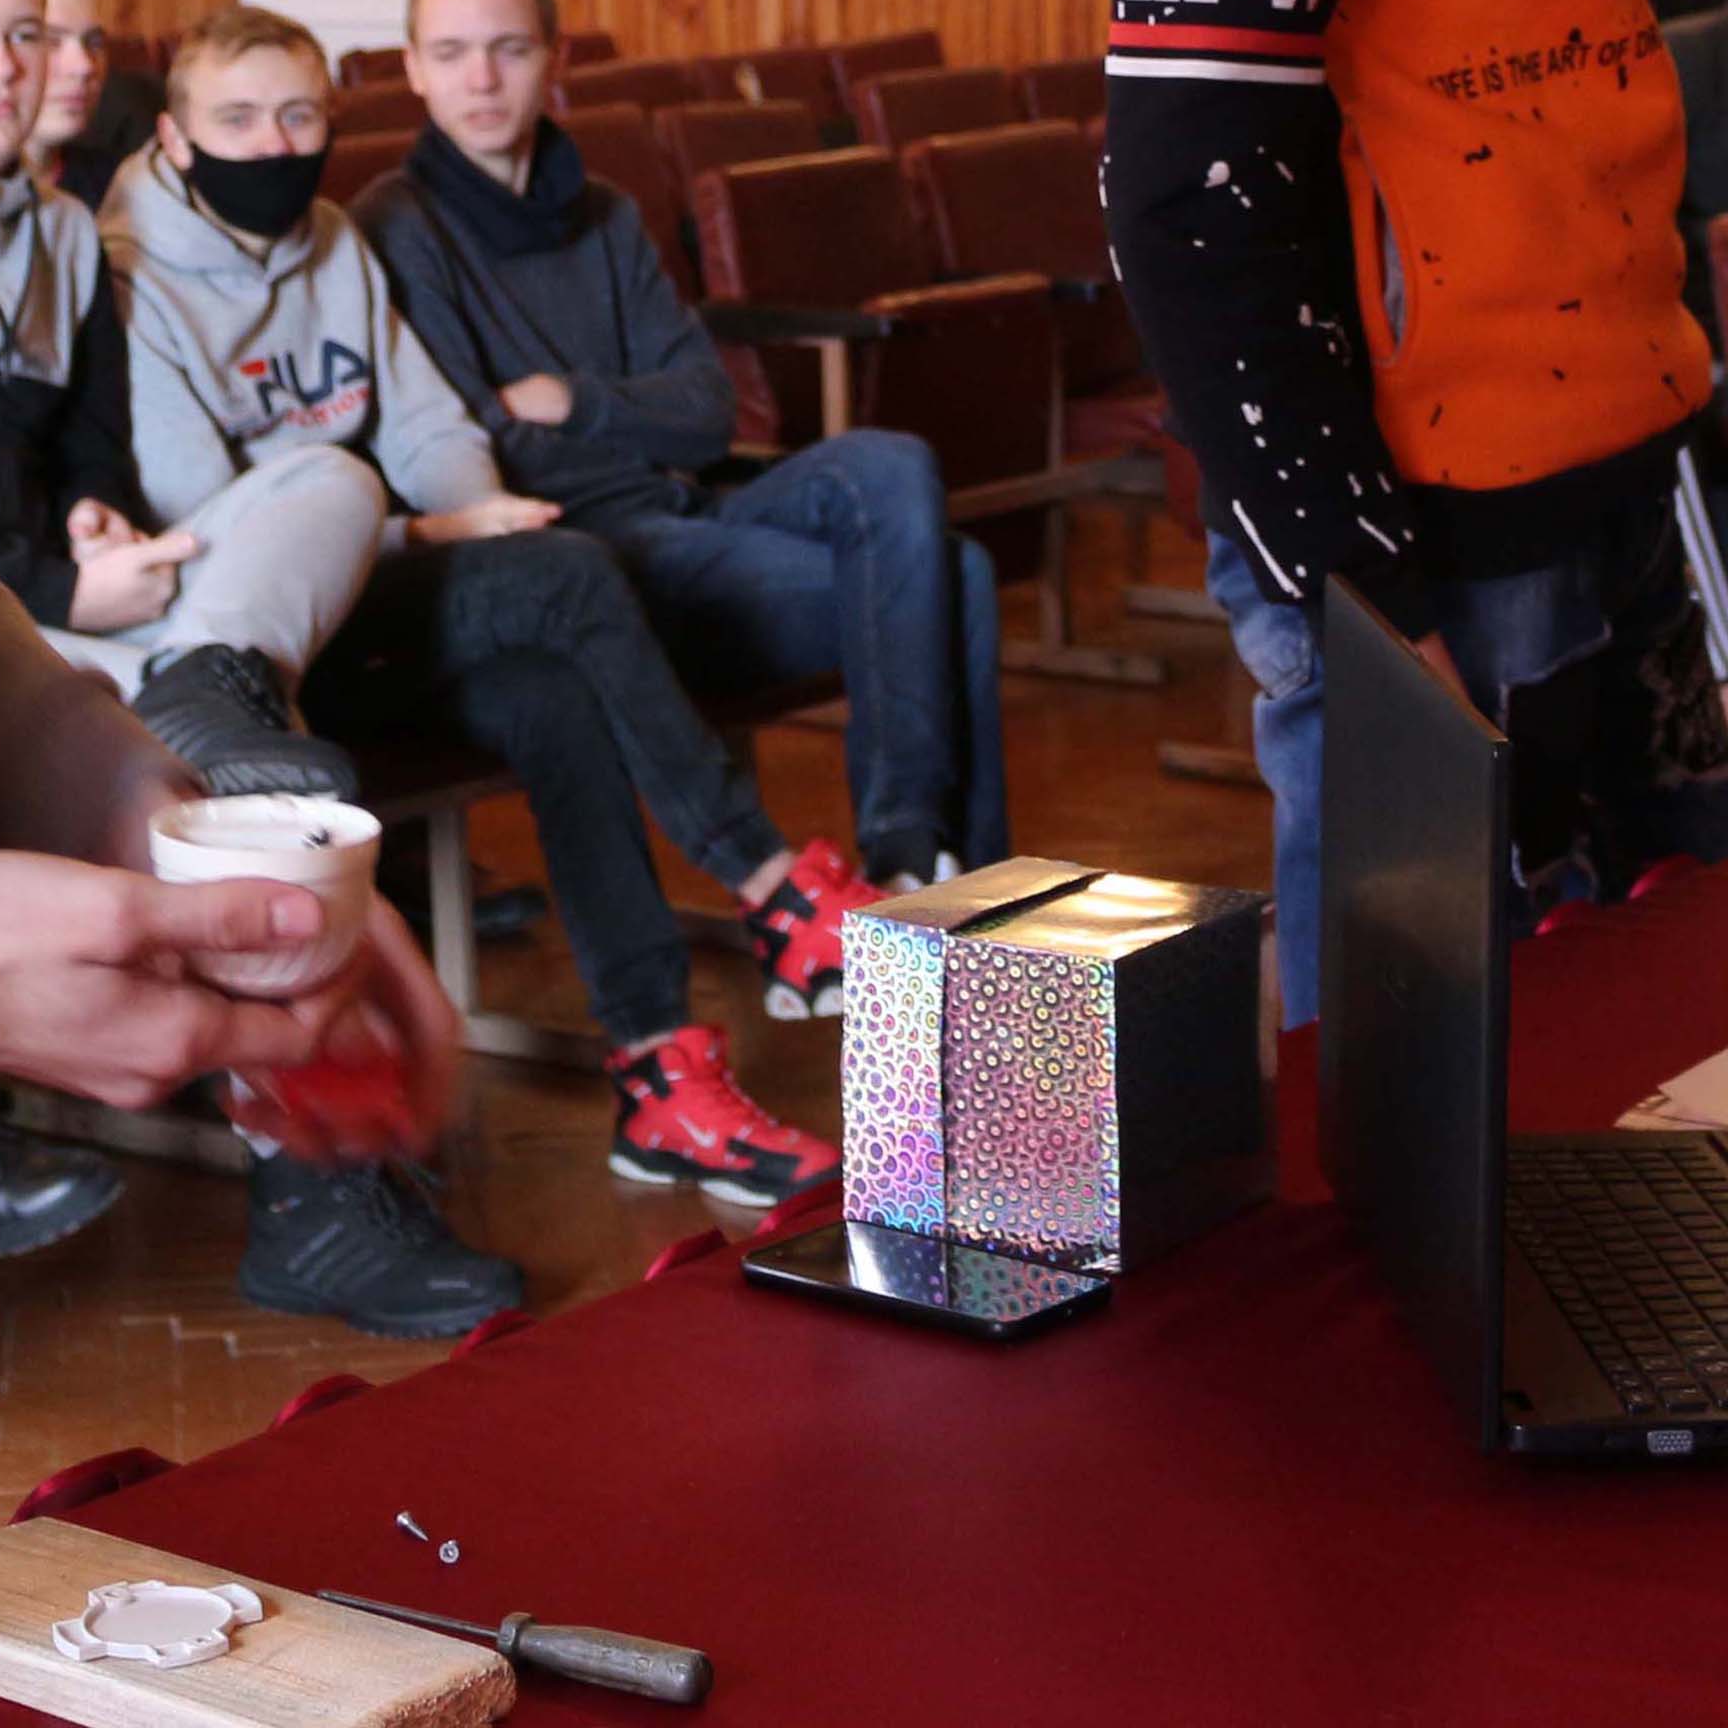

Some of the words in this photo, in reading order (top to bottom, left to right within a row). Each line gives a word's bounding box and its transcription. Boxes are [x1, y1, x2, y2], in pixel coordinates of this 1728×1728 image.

[1482, 62, 1505, 93] IS
[1506, 50, 1542, 87] THE
[1546, 41, 1592, 76] ART
[1597, 36, 1629, 67] OF
[238, 338, 375, 418] FILA
